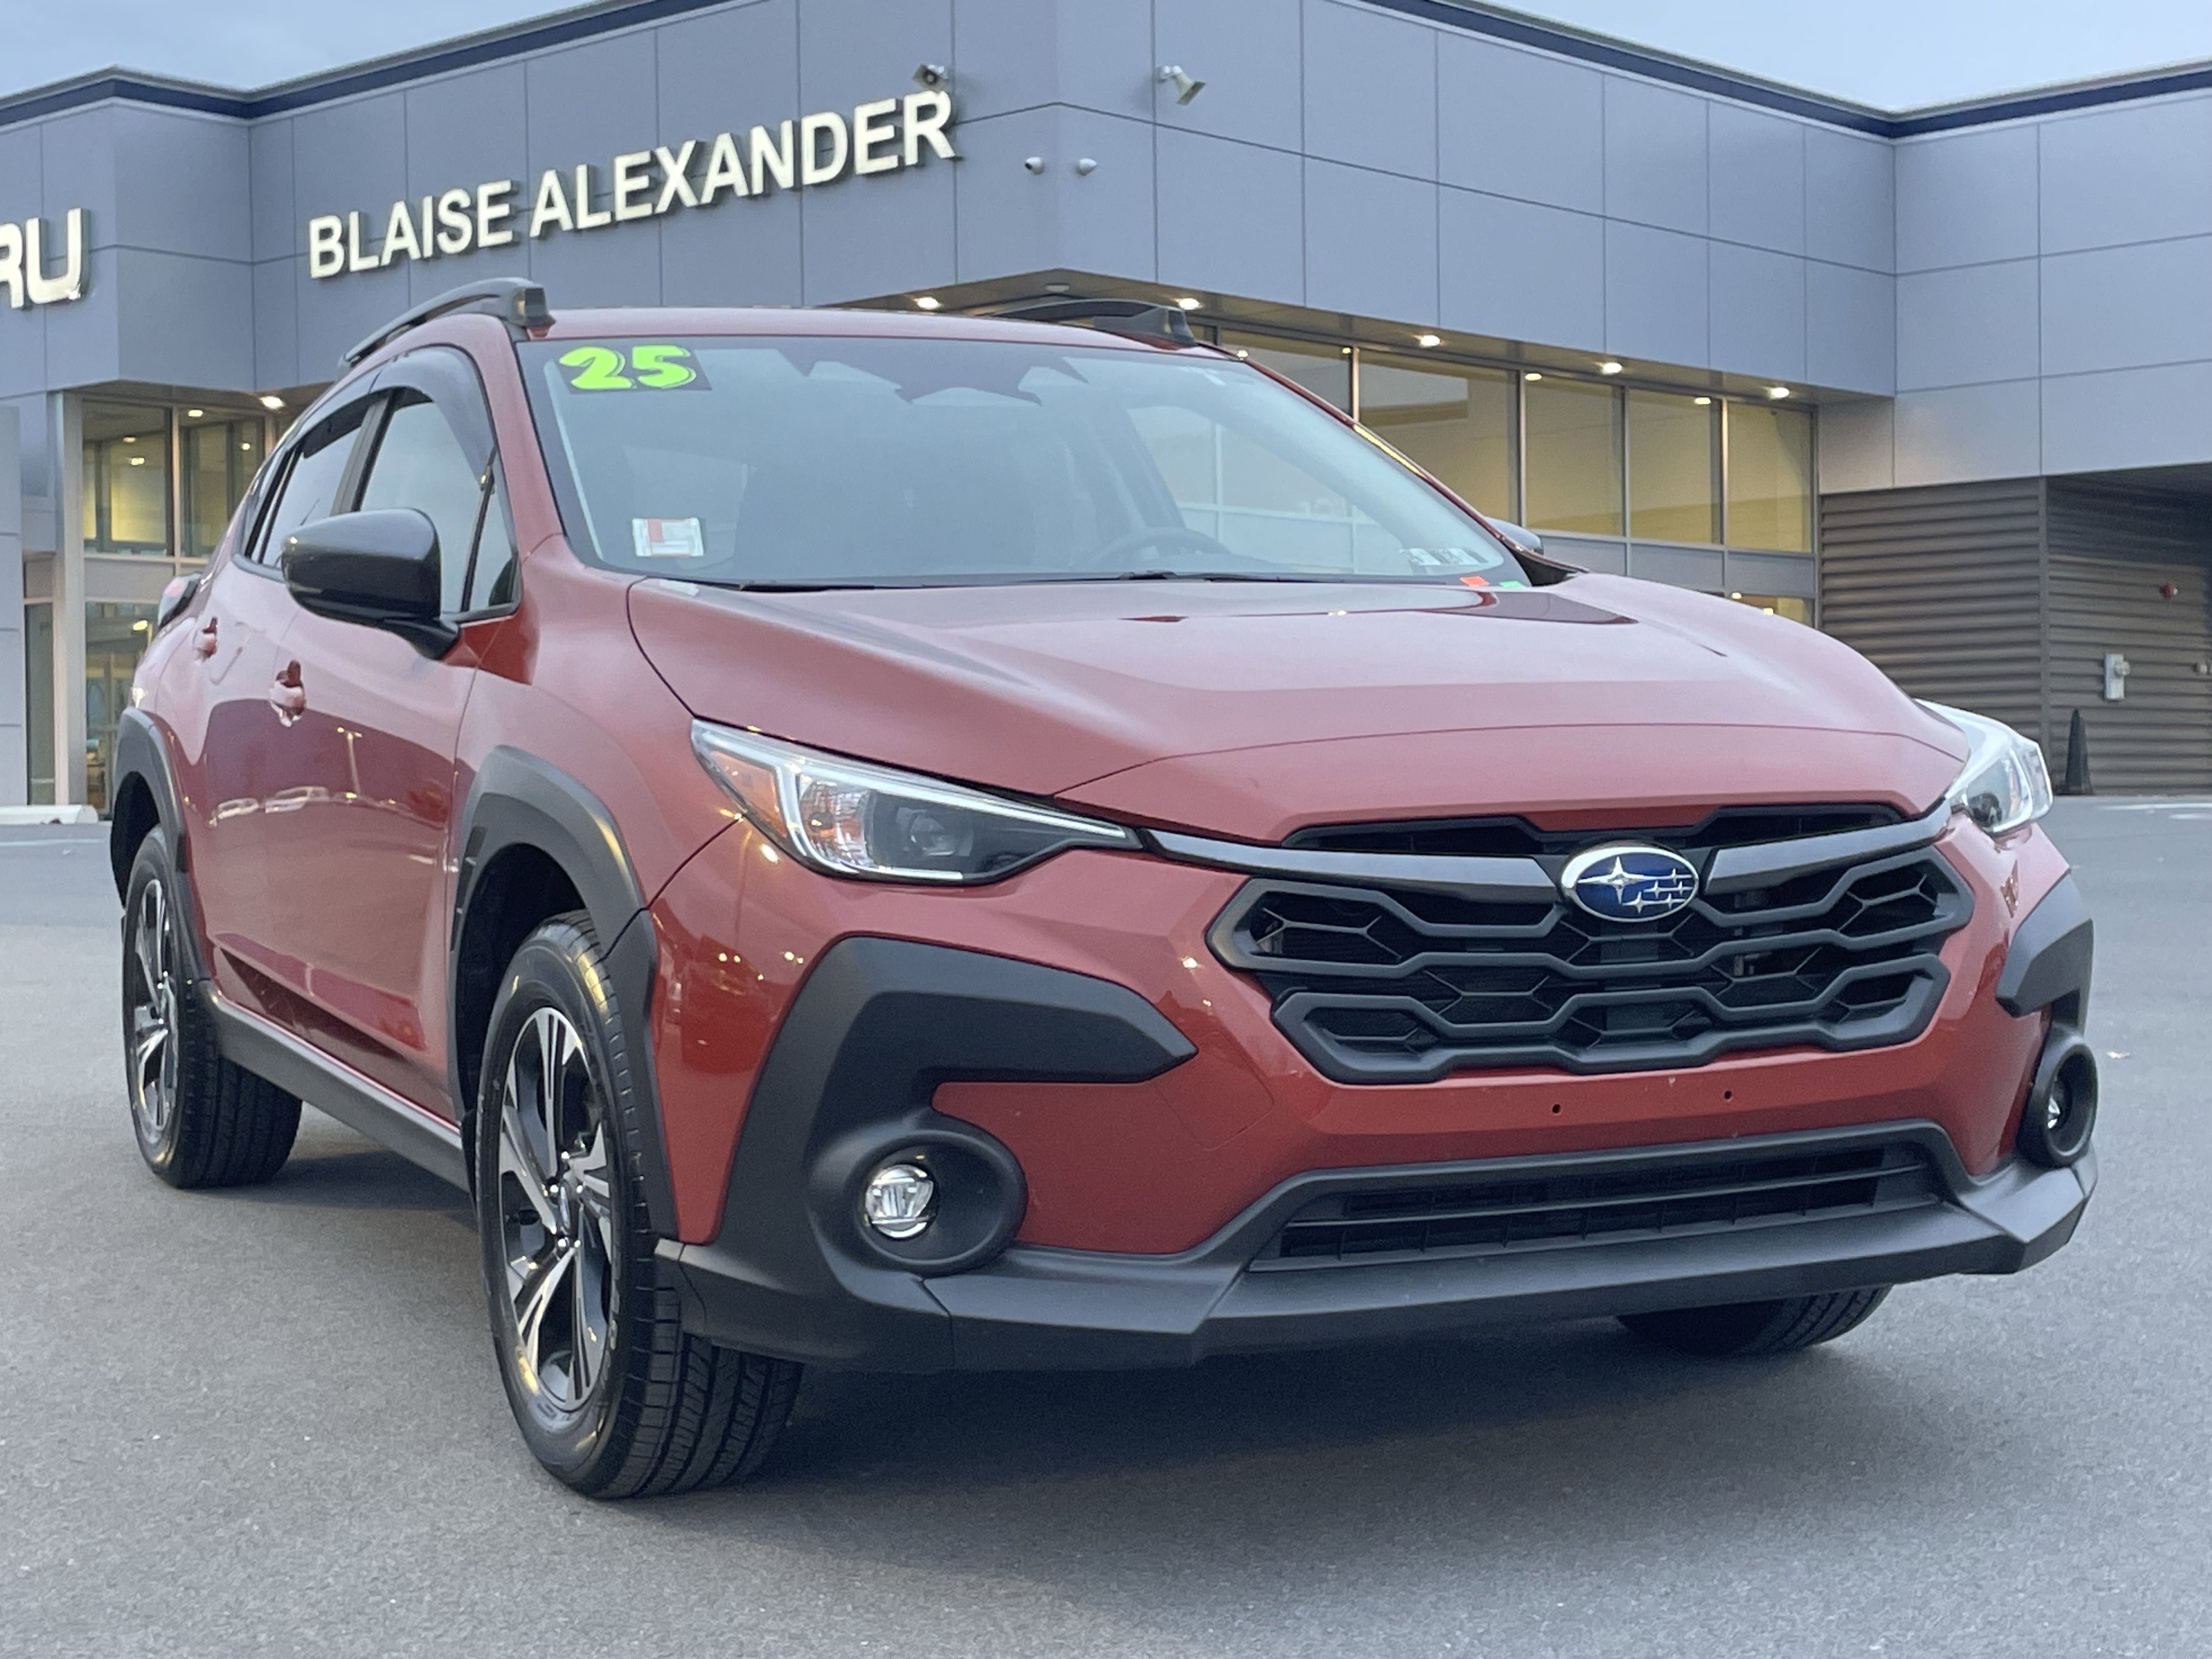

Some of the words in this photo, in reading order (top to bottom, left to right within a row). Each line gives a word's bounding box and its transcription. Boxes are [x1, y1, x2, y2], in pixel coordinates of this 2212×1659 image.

[309, 179, 514, 279] BLAISE
[529, 91, 956, 238] ALEXANDER
[558, 345, 696, 390] 25
